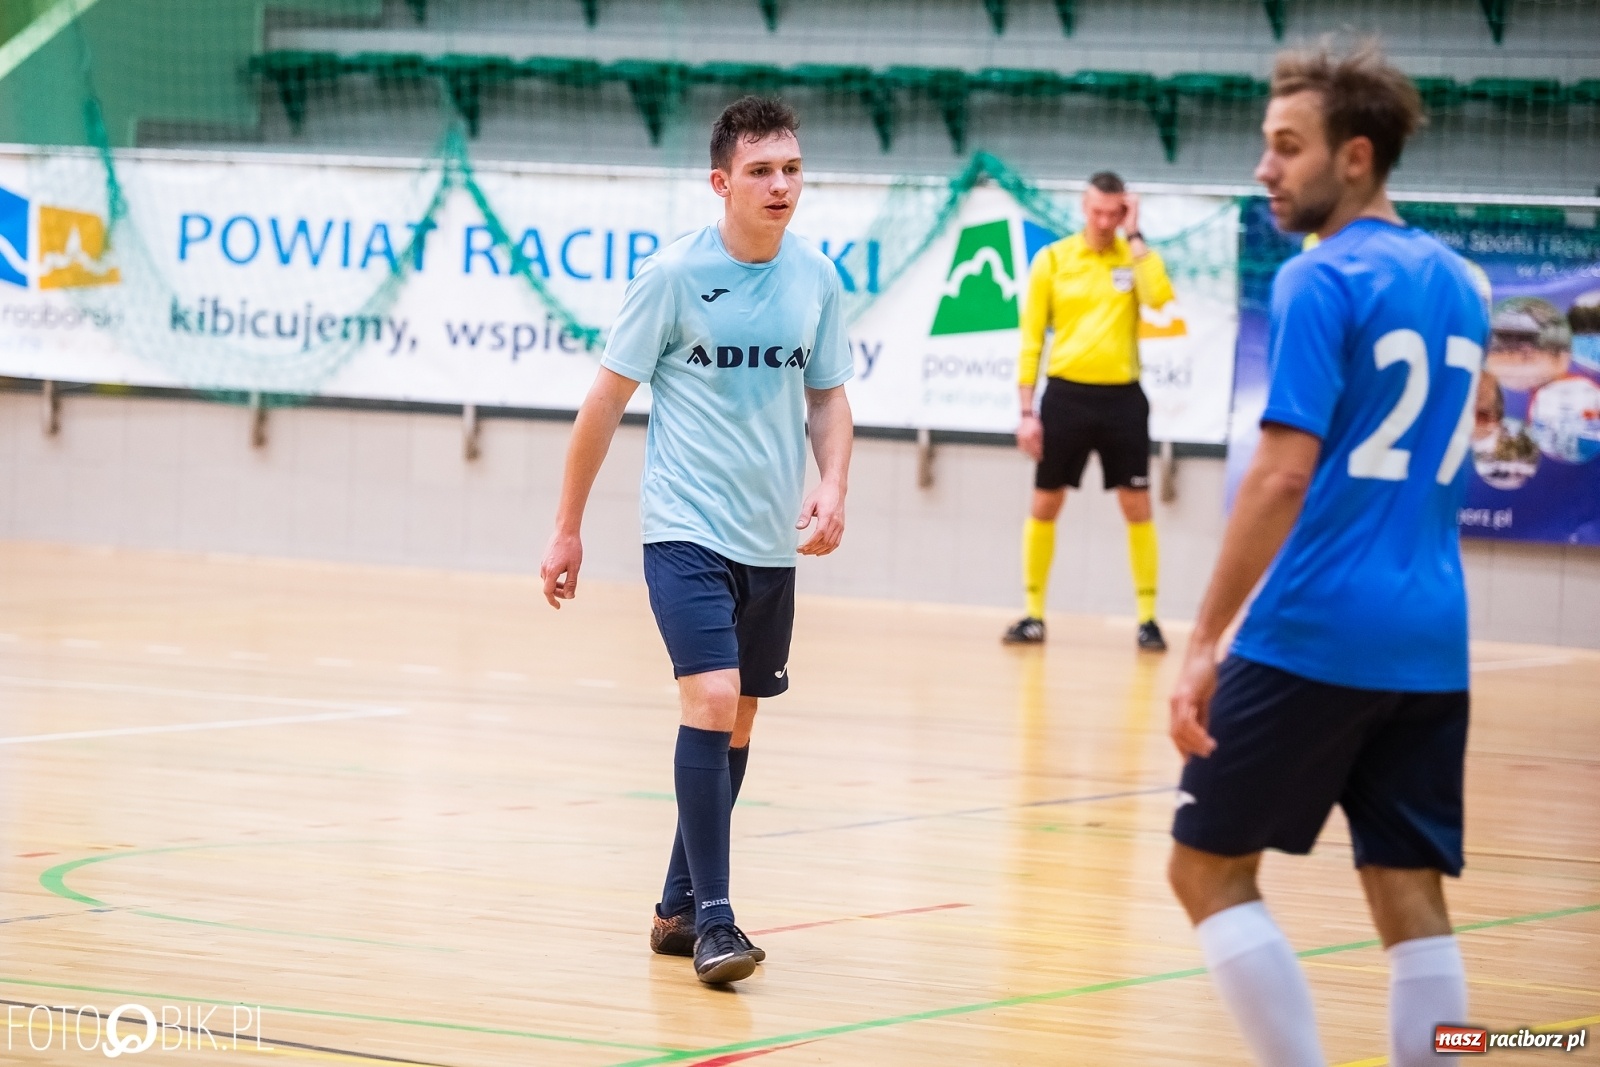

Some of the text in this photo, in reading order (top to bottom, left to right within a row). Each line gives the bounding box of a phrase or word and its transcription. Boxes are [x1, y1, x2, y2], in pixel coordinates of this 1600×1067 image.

[178, 213, 880, 294] POWIAT RACIBKI
[170, 297, 417, 355] kibicujemy,
[1347, 328, 1483, 486] 27
